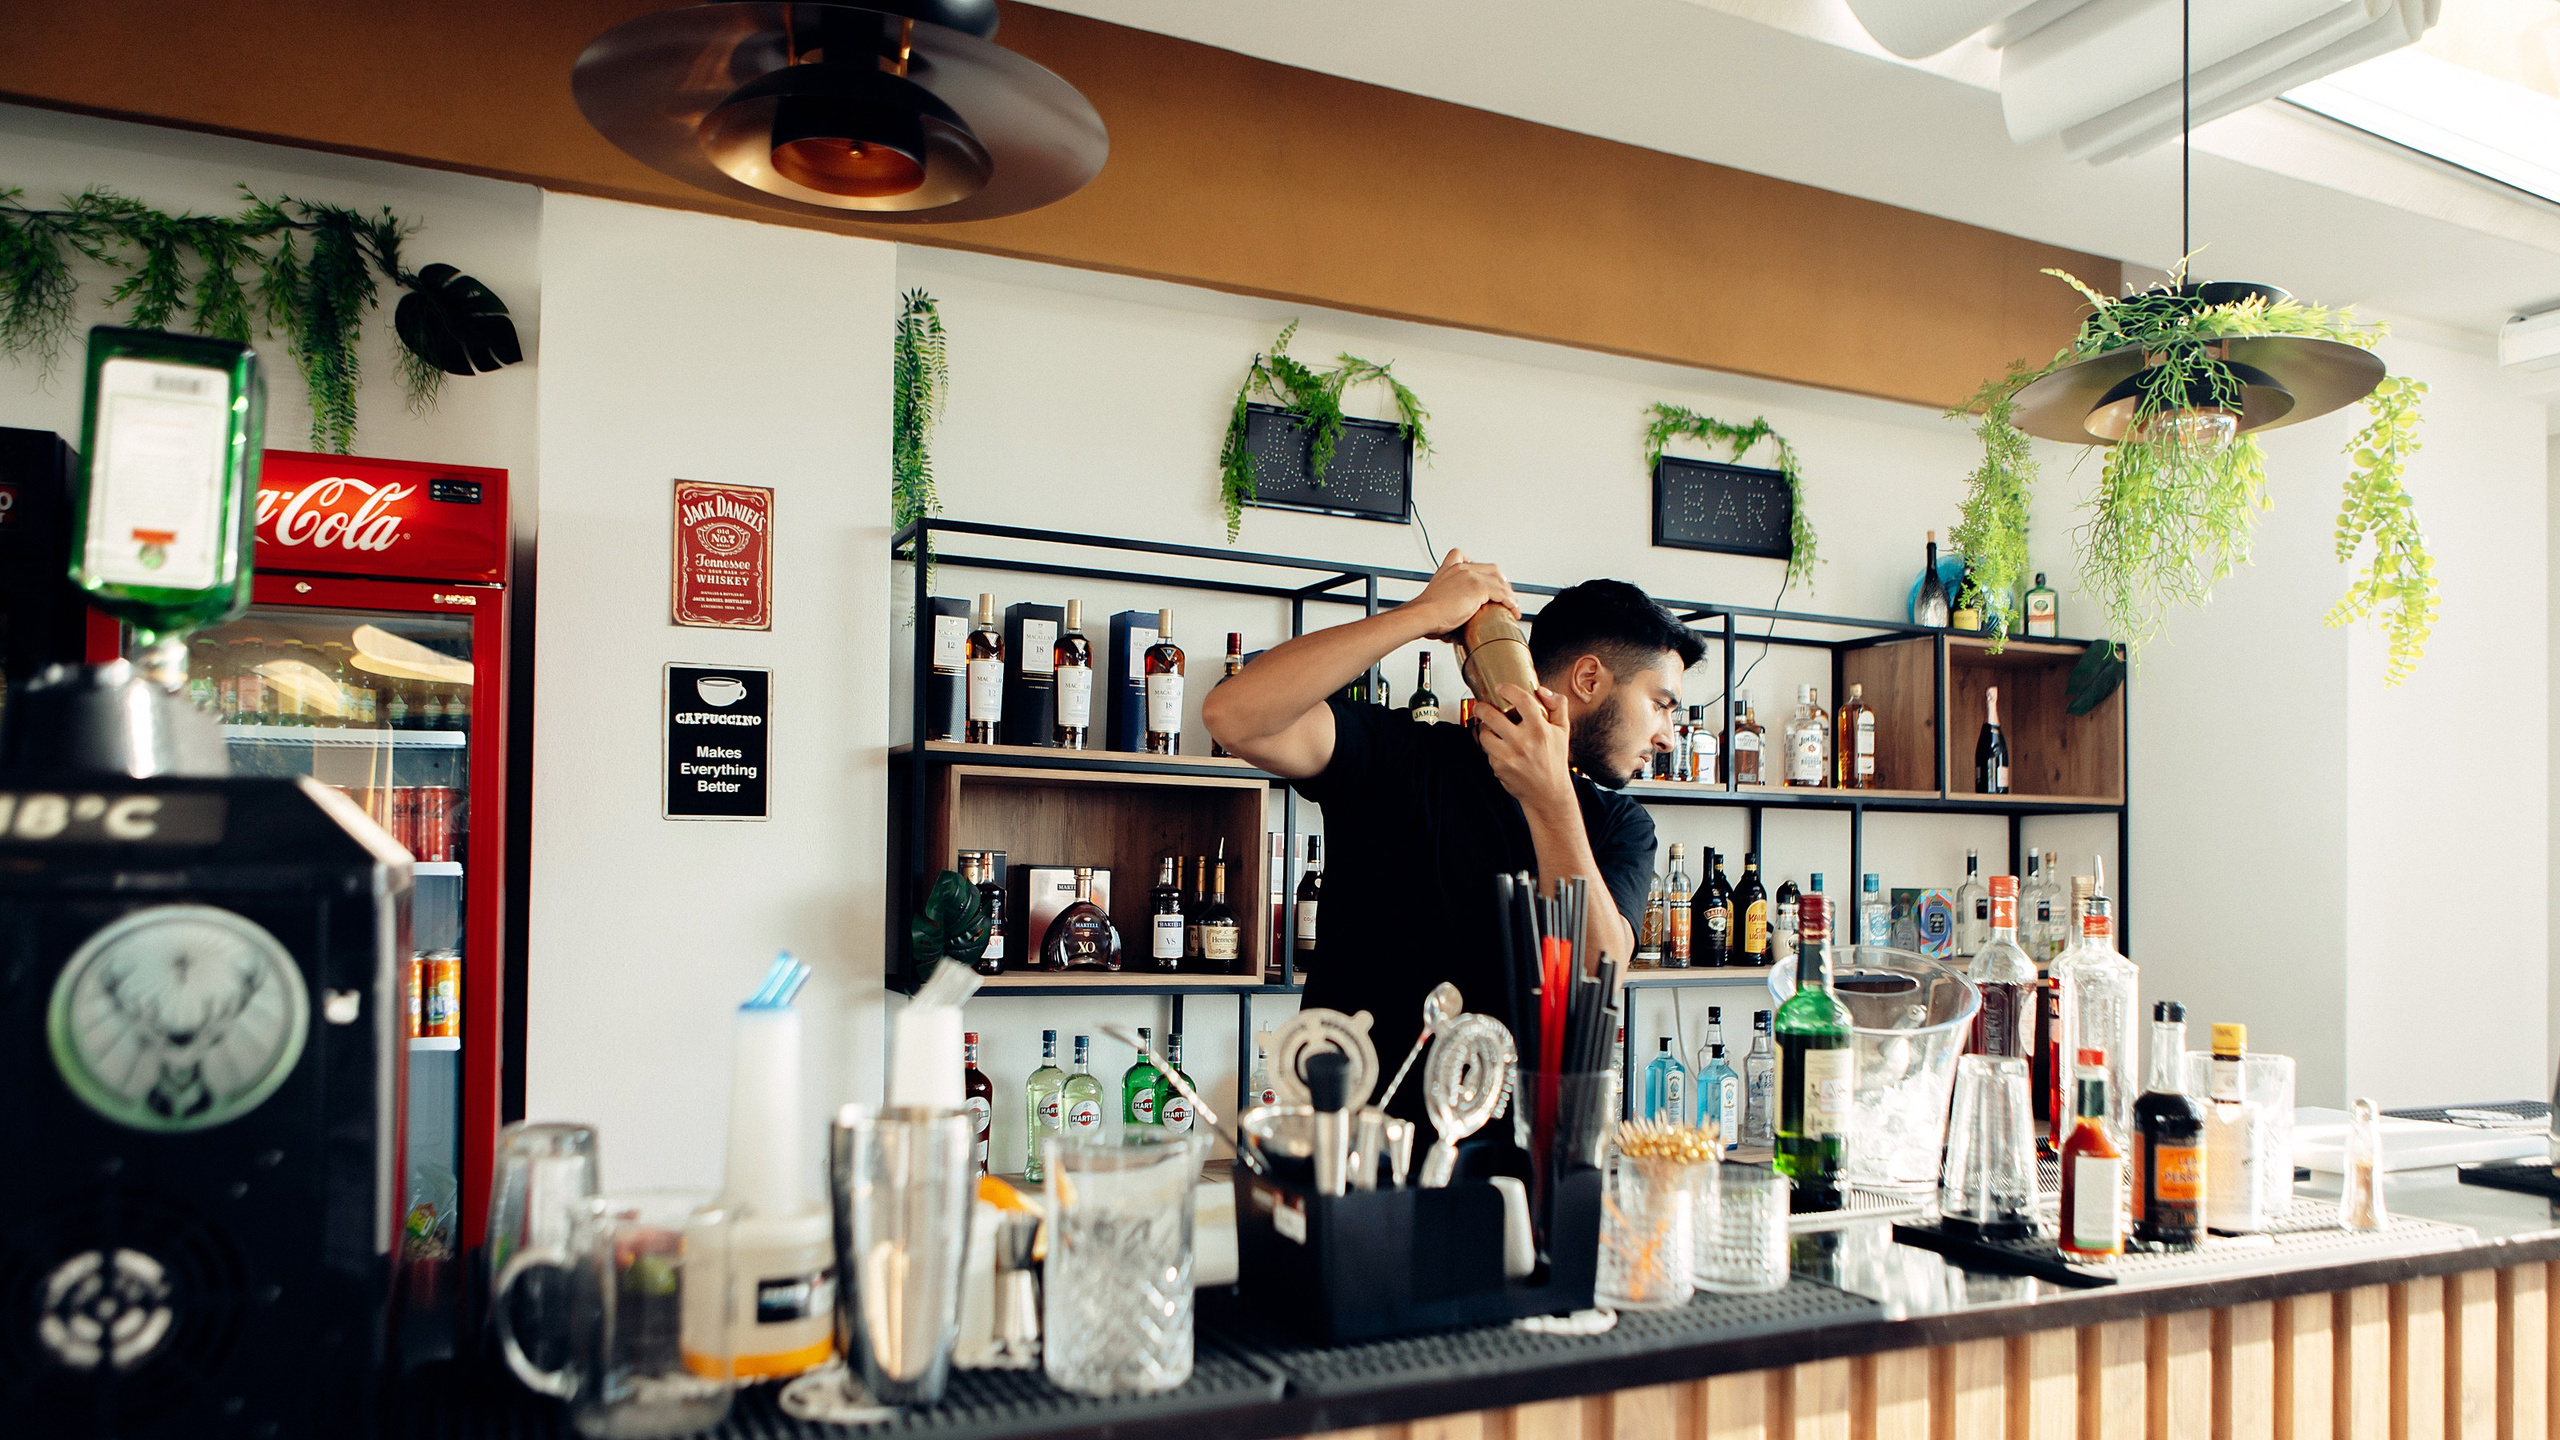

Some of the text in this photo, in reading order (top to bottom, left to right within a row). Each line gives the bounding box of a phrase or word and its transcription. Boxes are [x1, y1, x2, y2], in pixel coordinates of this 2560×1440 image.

[1683, 483, 1767, 531] BAR
[682, 495, 767, 532] JACK DANIEL'S
[695, 553, 751, 570] Tennessee
[696, 574, 750, 586] WHISKEY
[946, 641, 956, 649] 12
[1036, 645, 1044, 653] 18
[675, 712, 762, 726] CAPPUCCINO
[696, 745, 743, 759] Makes
[680, 762, 758, 780] Everything
[697, 780, 741, 793] Better
[1166, 937, 1177, 945] VS
[1211, 936, 1238, 944] Henness
[1078, 941, 1096, 953] XO
[1040, 1107, 1058, 1115] MART
[1071, 1113, 1100, 1123] MARTINI
